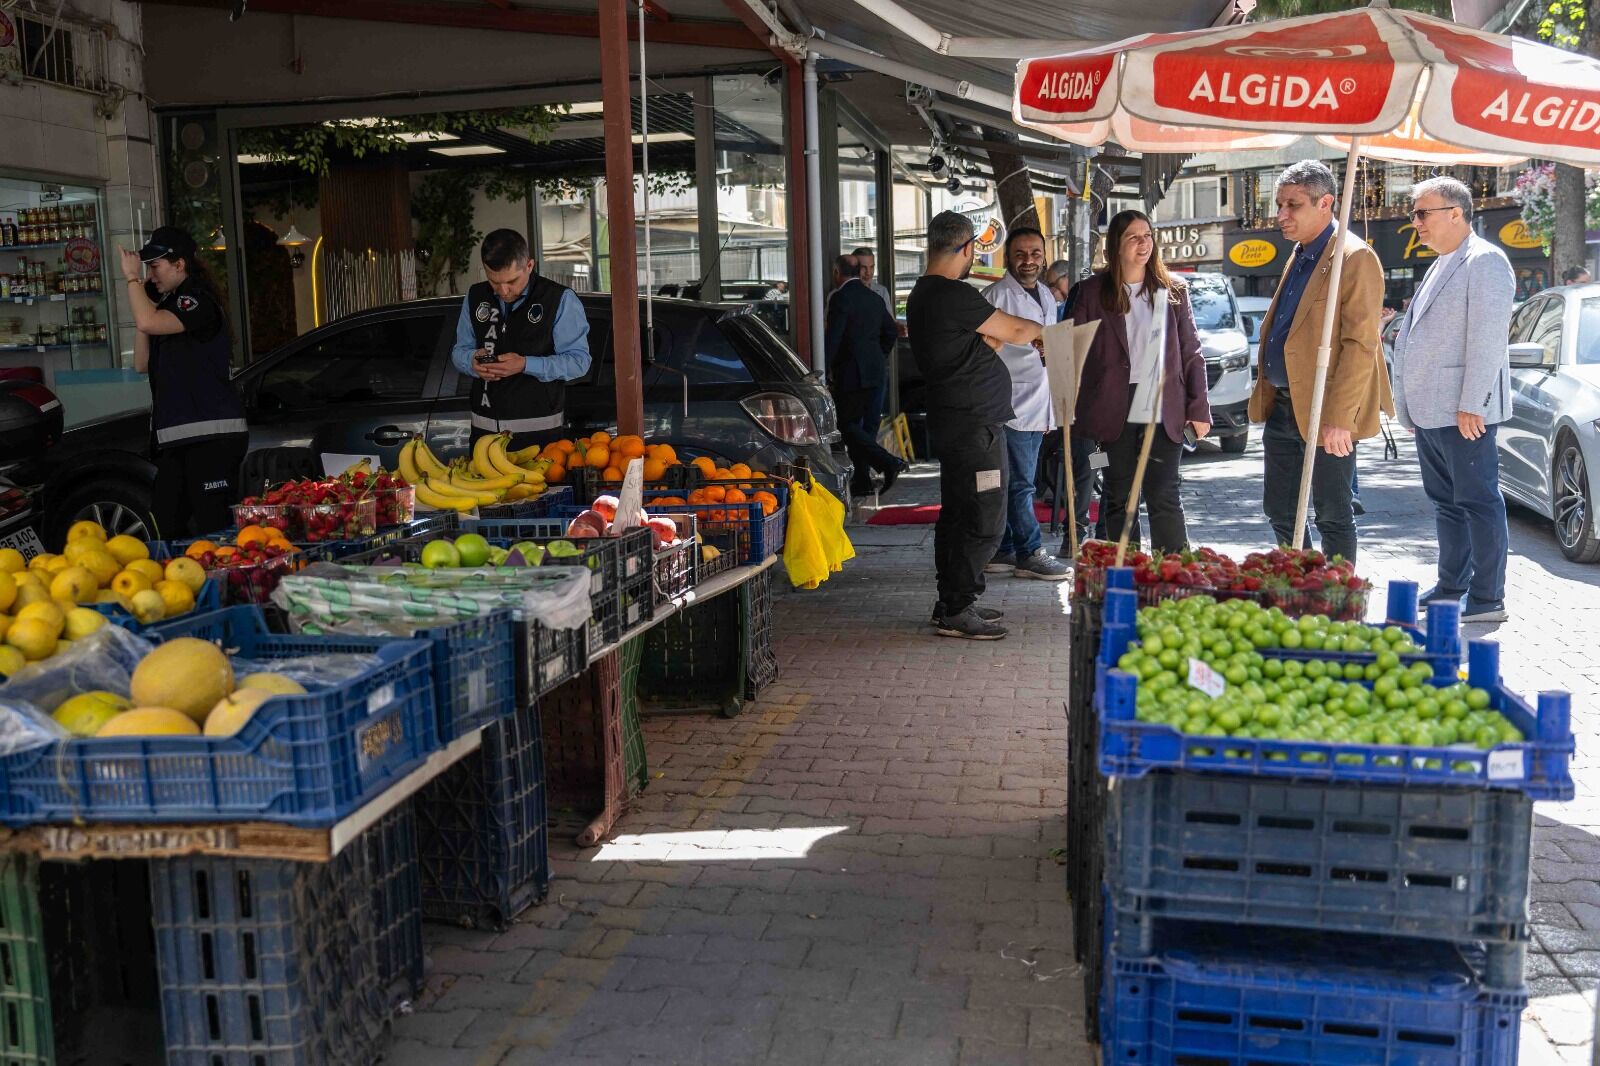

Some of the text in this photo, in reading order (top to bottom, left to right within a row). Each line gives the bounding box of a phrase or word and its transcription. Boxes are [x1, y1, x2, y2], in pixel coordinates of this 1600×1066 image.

[1480, 88, 1600, 135] ALGiD
[204, 479, 228, 490] ZABITA
[20, 545, 39, 562] 86
